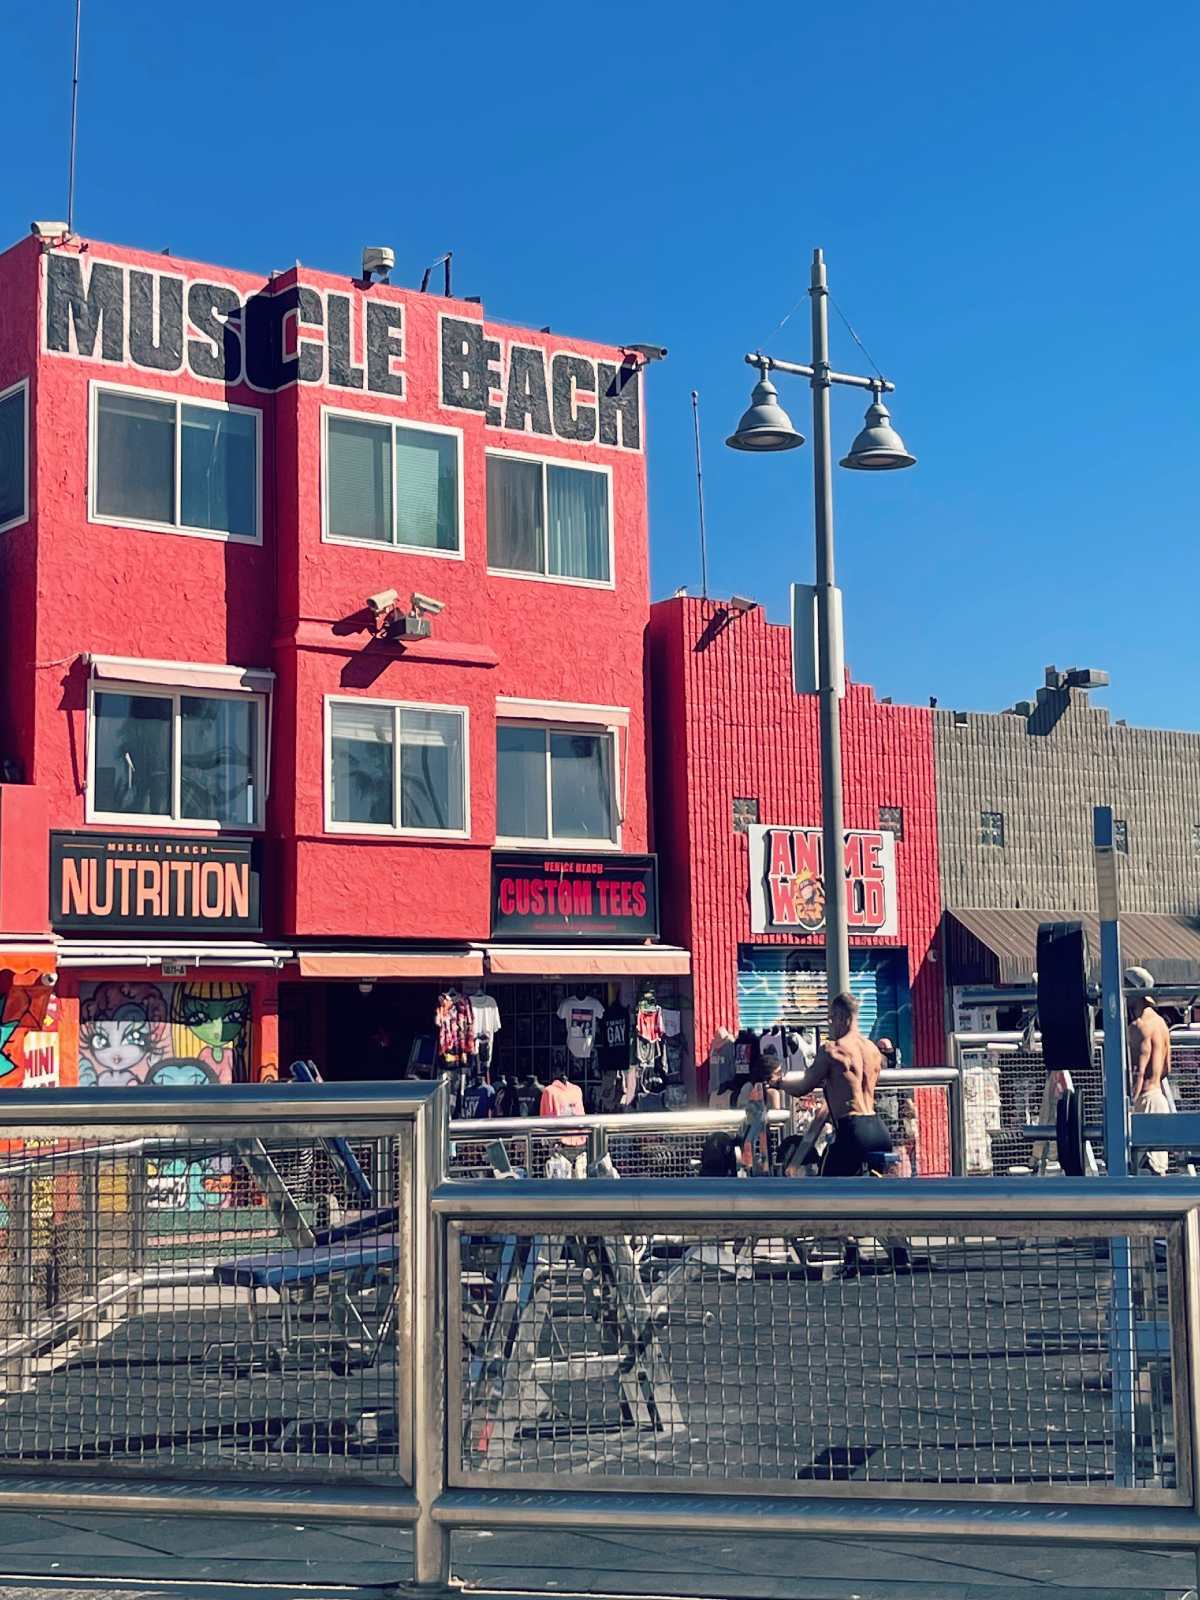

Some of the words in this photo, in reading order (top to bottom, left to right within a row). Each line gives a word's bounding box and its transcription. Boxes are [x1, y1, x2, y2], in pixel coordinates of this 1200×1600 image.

[44, 250, 406, 396] MUSCLE
[438, 313, 642, 453] BEACH
[107, 842, 160, 853] MUSCLE
[165, 844, 208, 855] BEACH
[543, 861, 574, 873] VENICE
[575, 863, 604, 875] BEACH
[766, 829, 884, 879] ANME
[61, 857, 249, 918] NUTRITION
[499, 877, 592, 917] CUSTOM
[596, 880, 648, 918] TEES
[768, 876, 885, 926] WLD
